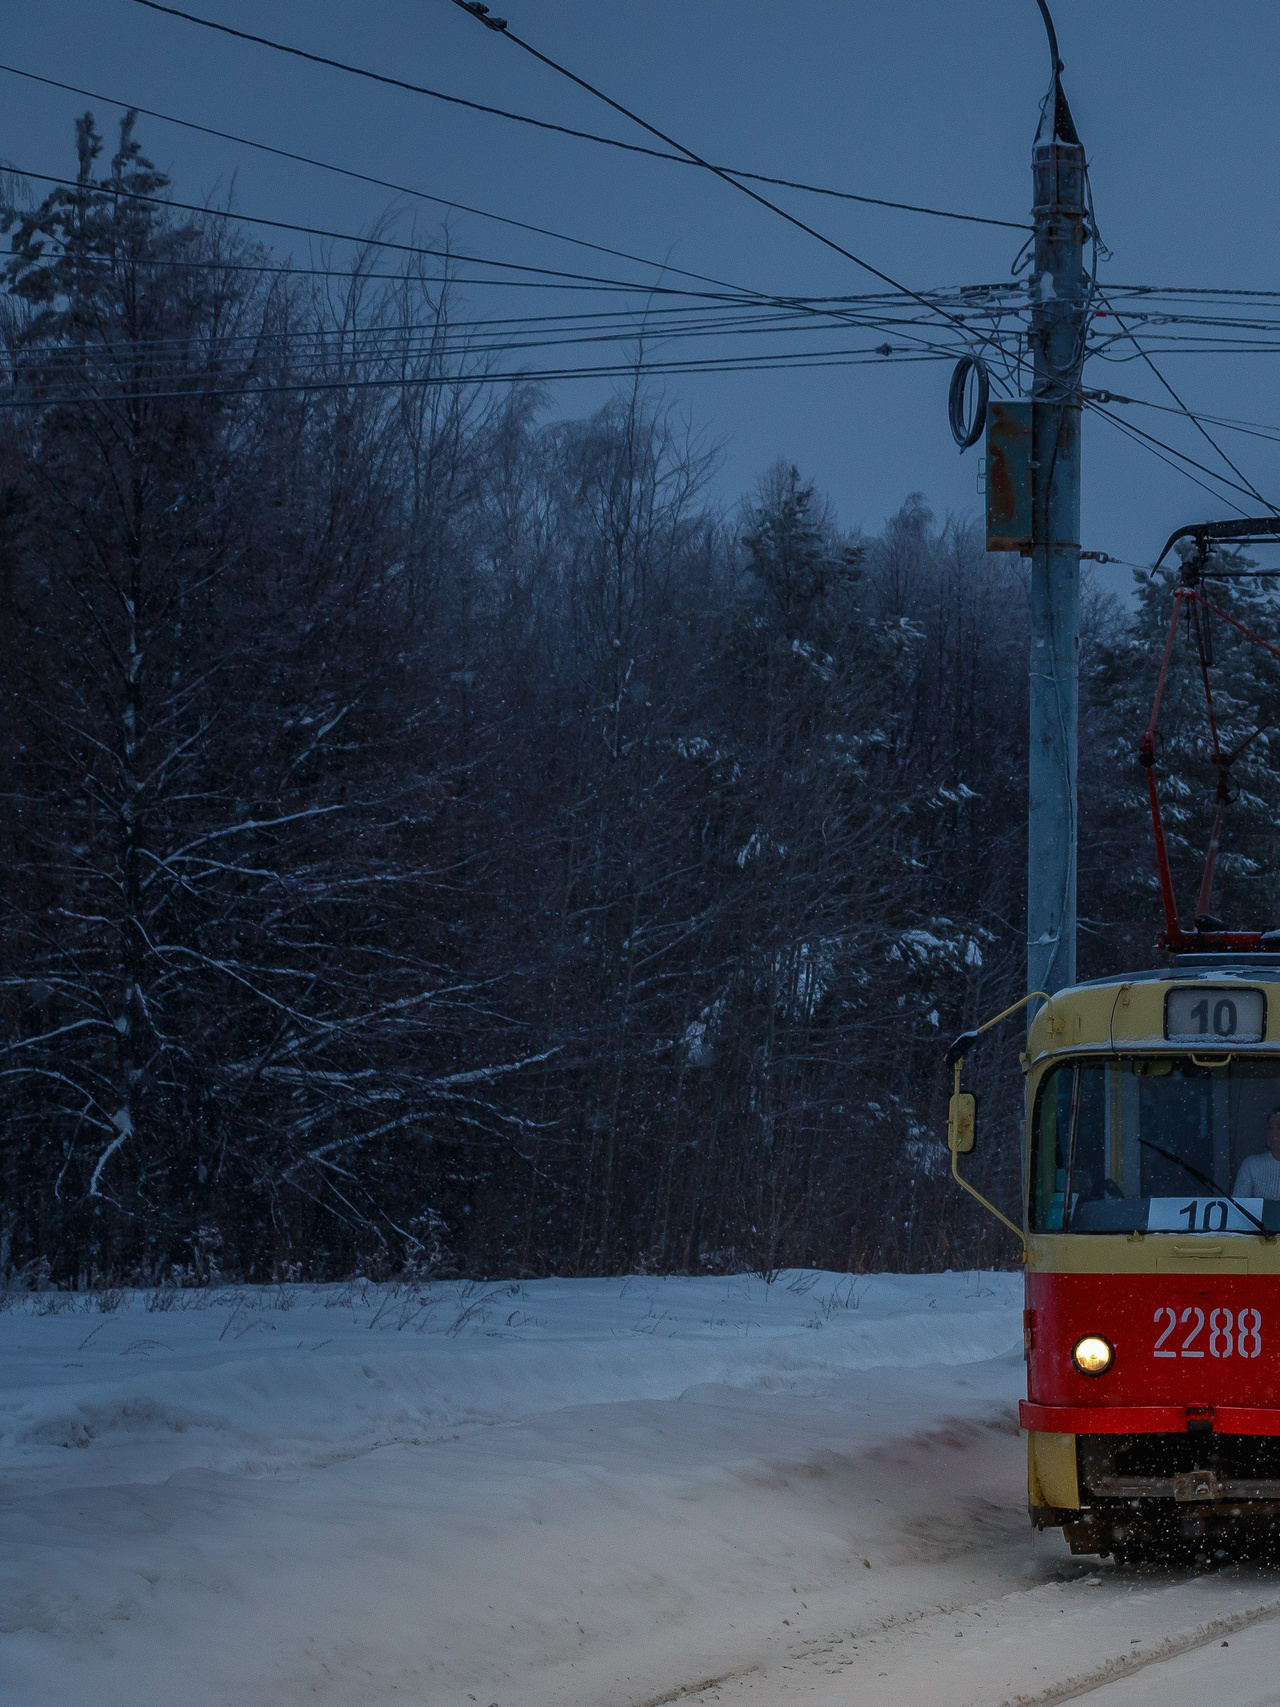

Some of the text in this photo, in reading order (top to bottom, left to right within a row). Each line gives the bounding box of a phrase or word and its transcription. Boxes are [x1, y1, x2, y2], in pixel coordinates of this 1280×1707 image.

[1191, 999, 1237, 1037] 10
[1180, 1200, 1228, 1230] 10
[1153, 1307, 1261, 1358] 2288
